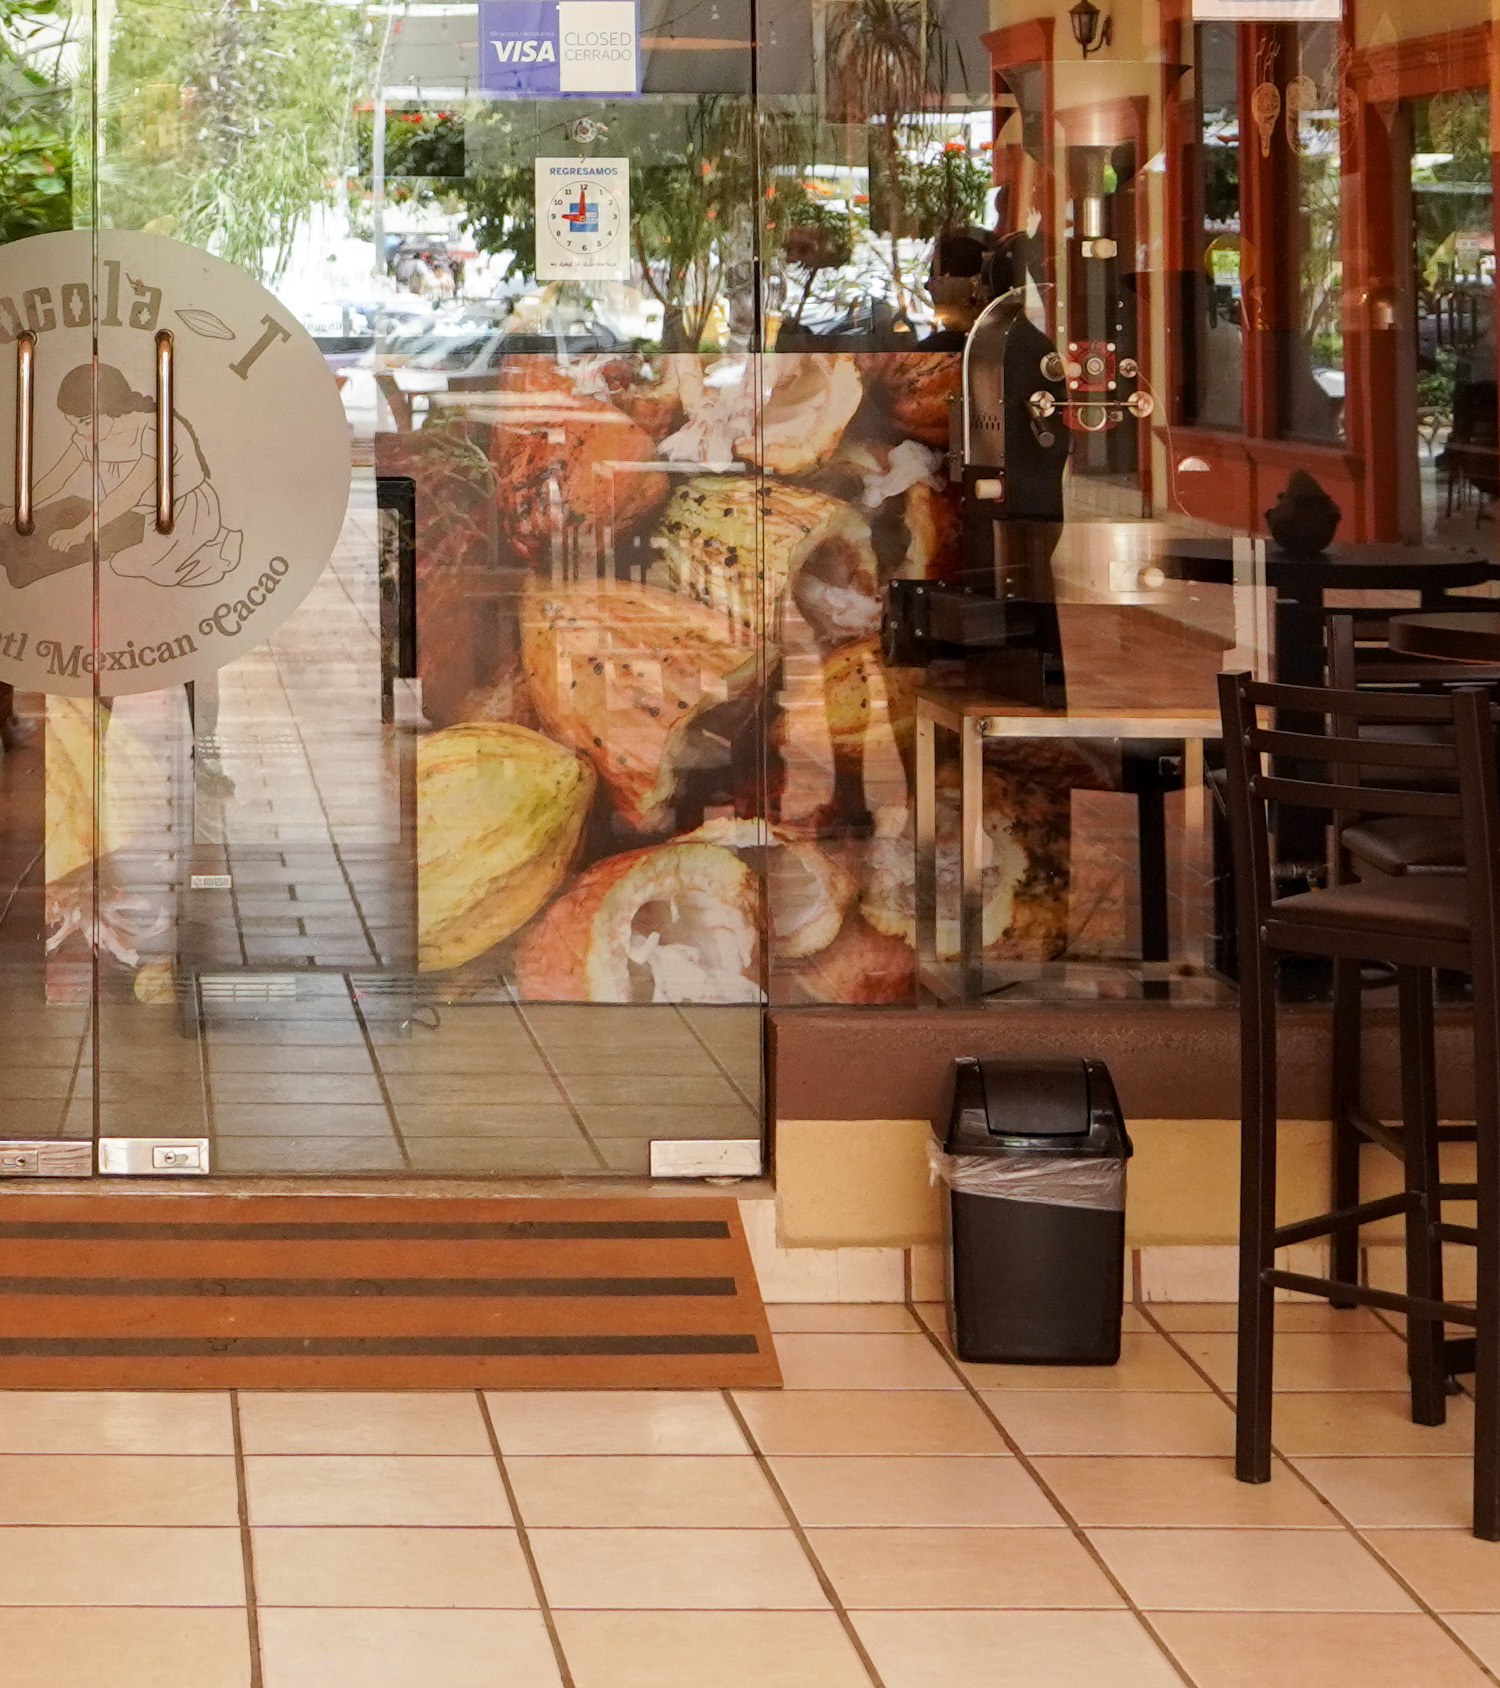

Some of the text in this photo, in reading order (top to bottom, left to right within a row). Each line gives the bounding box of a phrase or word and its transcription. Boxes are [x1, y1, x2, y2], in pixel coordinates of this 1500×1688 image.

[564, 31, 632, 47] CLOSED
[490, 40, 556, 63] VISA
[565, 49, 632, 61] CERRADO
[549, 167, 619, 176] REGRESAMOS
[35, 629, 198, 679] Mexican
[198, 555, 290, 637] Cacao
